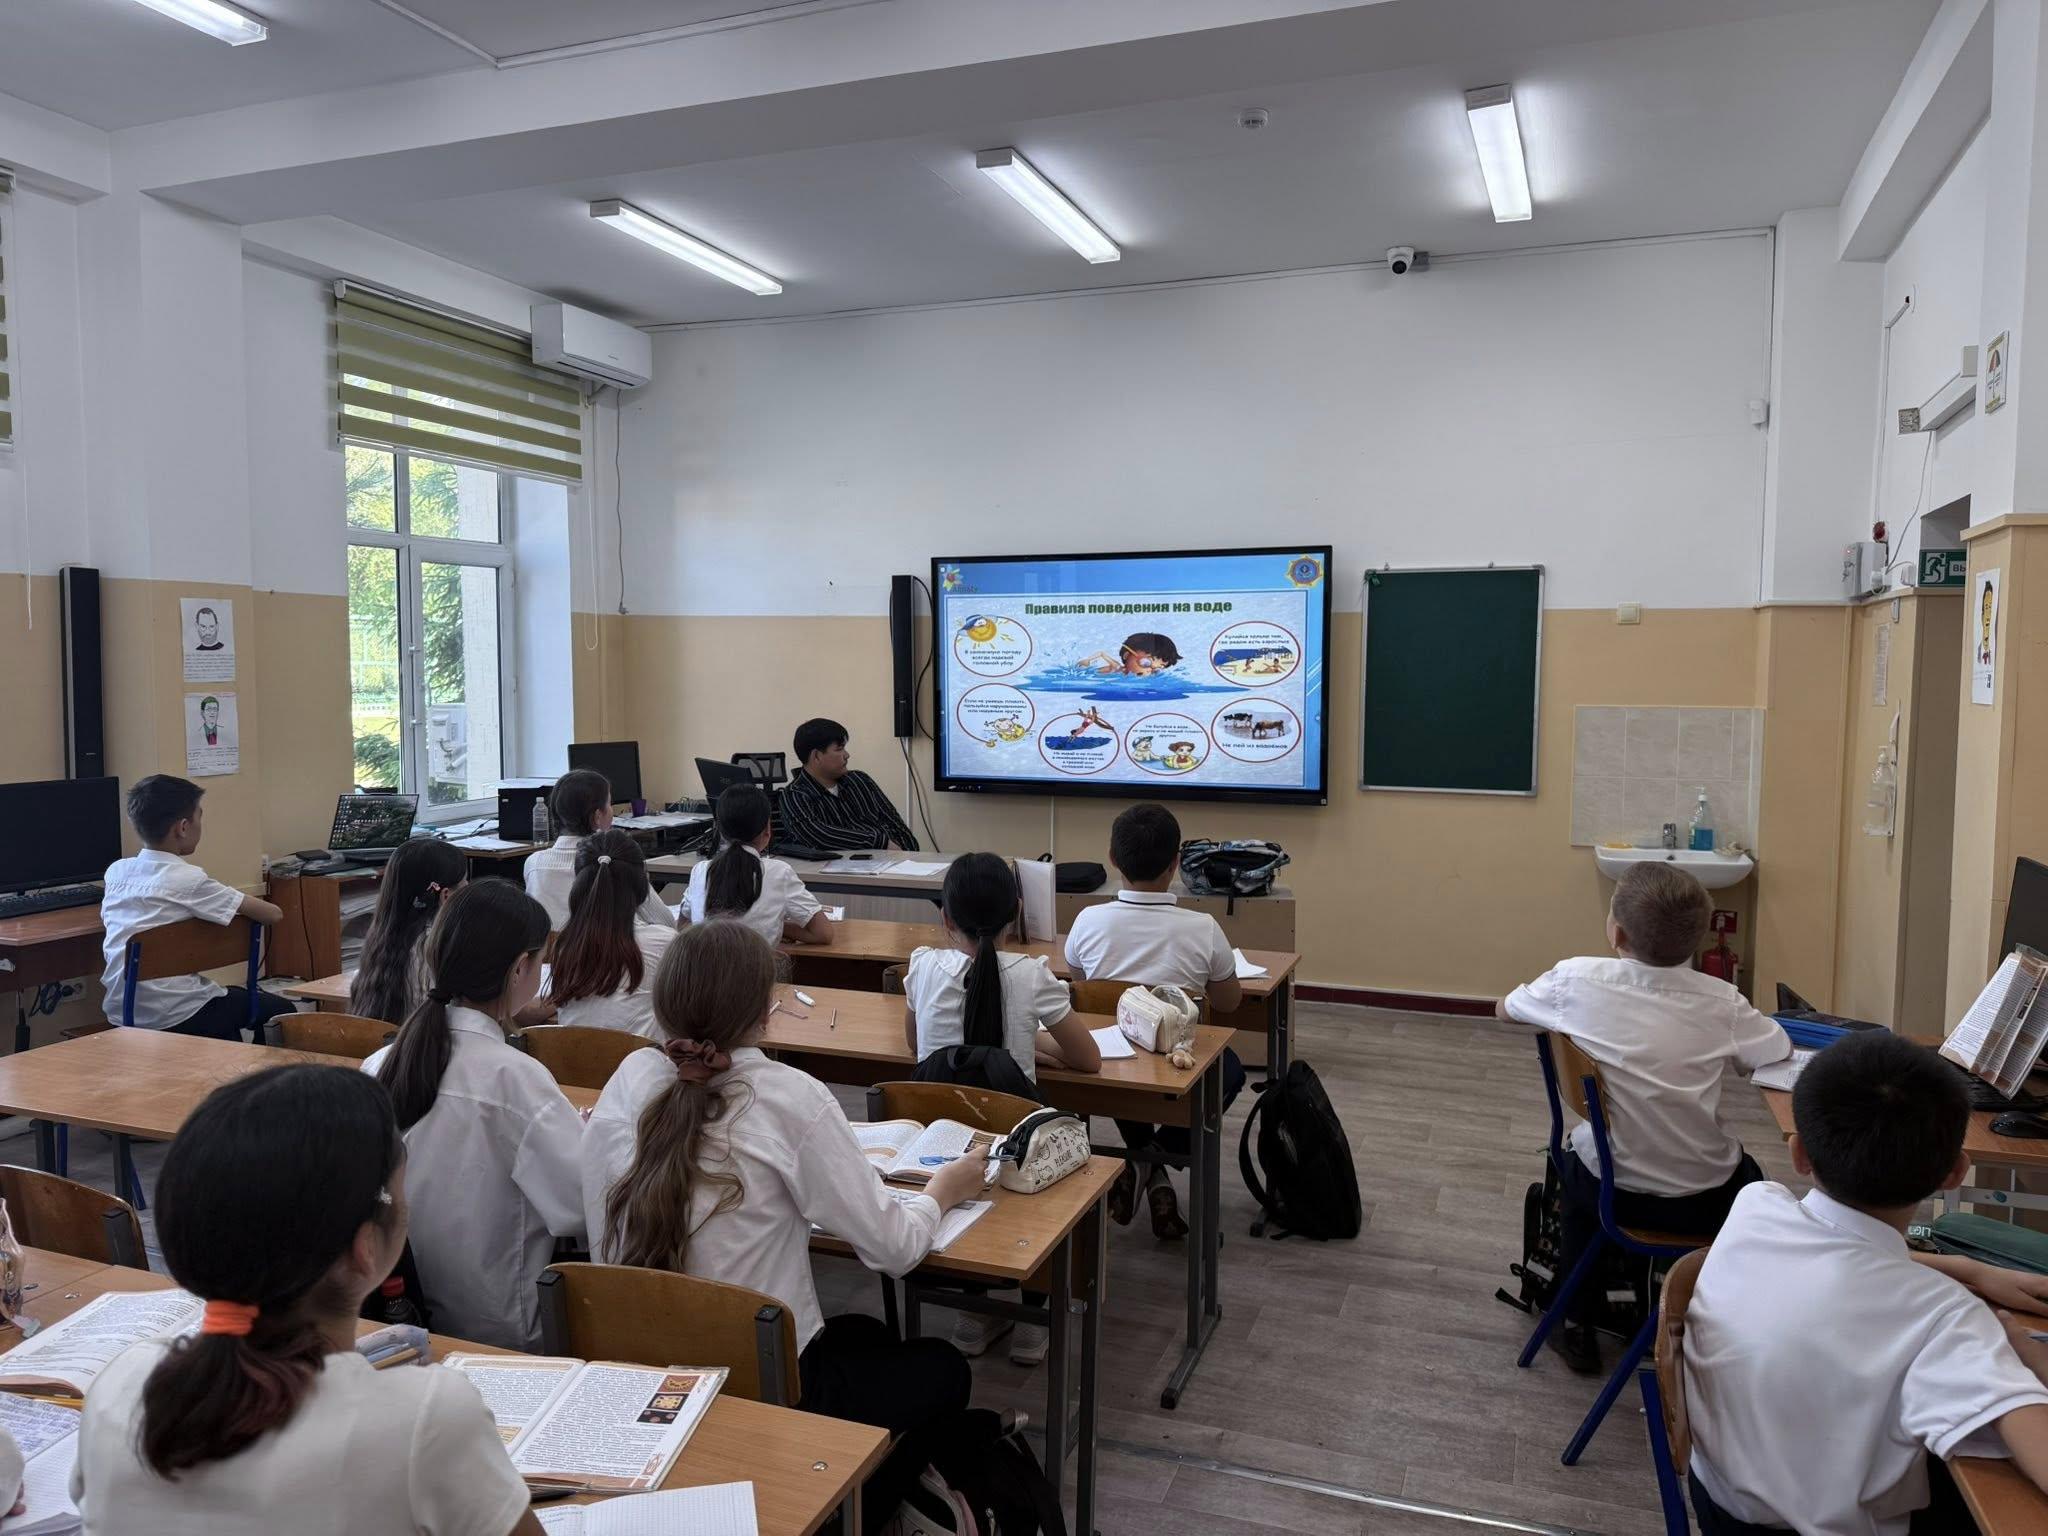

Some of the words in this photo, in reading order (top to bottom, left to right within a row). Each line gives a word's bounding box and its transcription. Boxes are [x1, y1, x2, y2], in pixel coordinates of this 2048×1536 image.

[1025, 603, 1085, 616] Правила
[1088, 603, 1169, 614] поведения
[1172, 602, 1191, 613] на
[1194, 601, 1232, 613] воде
